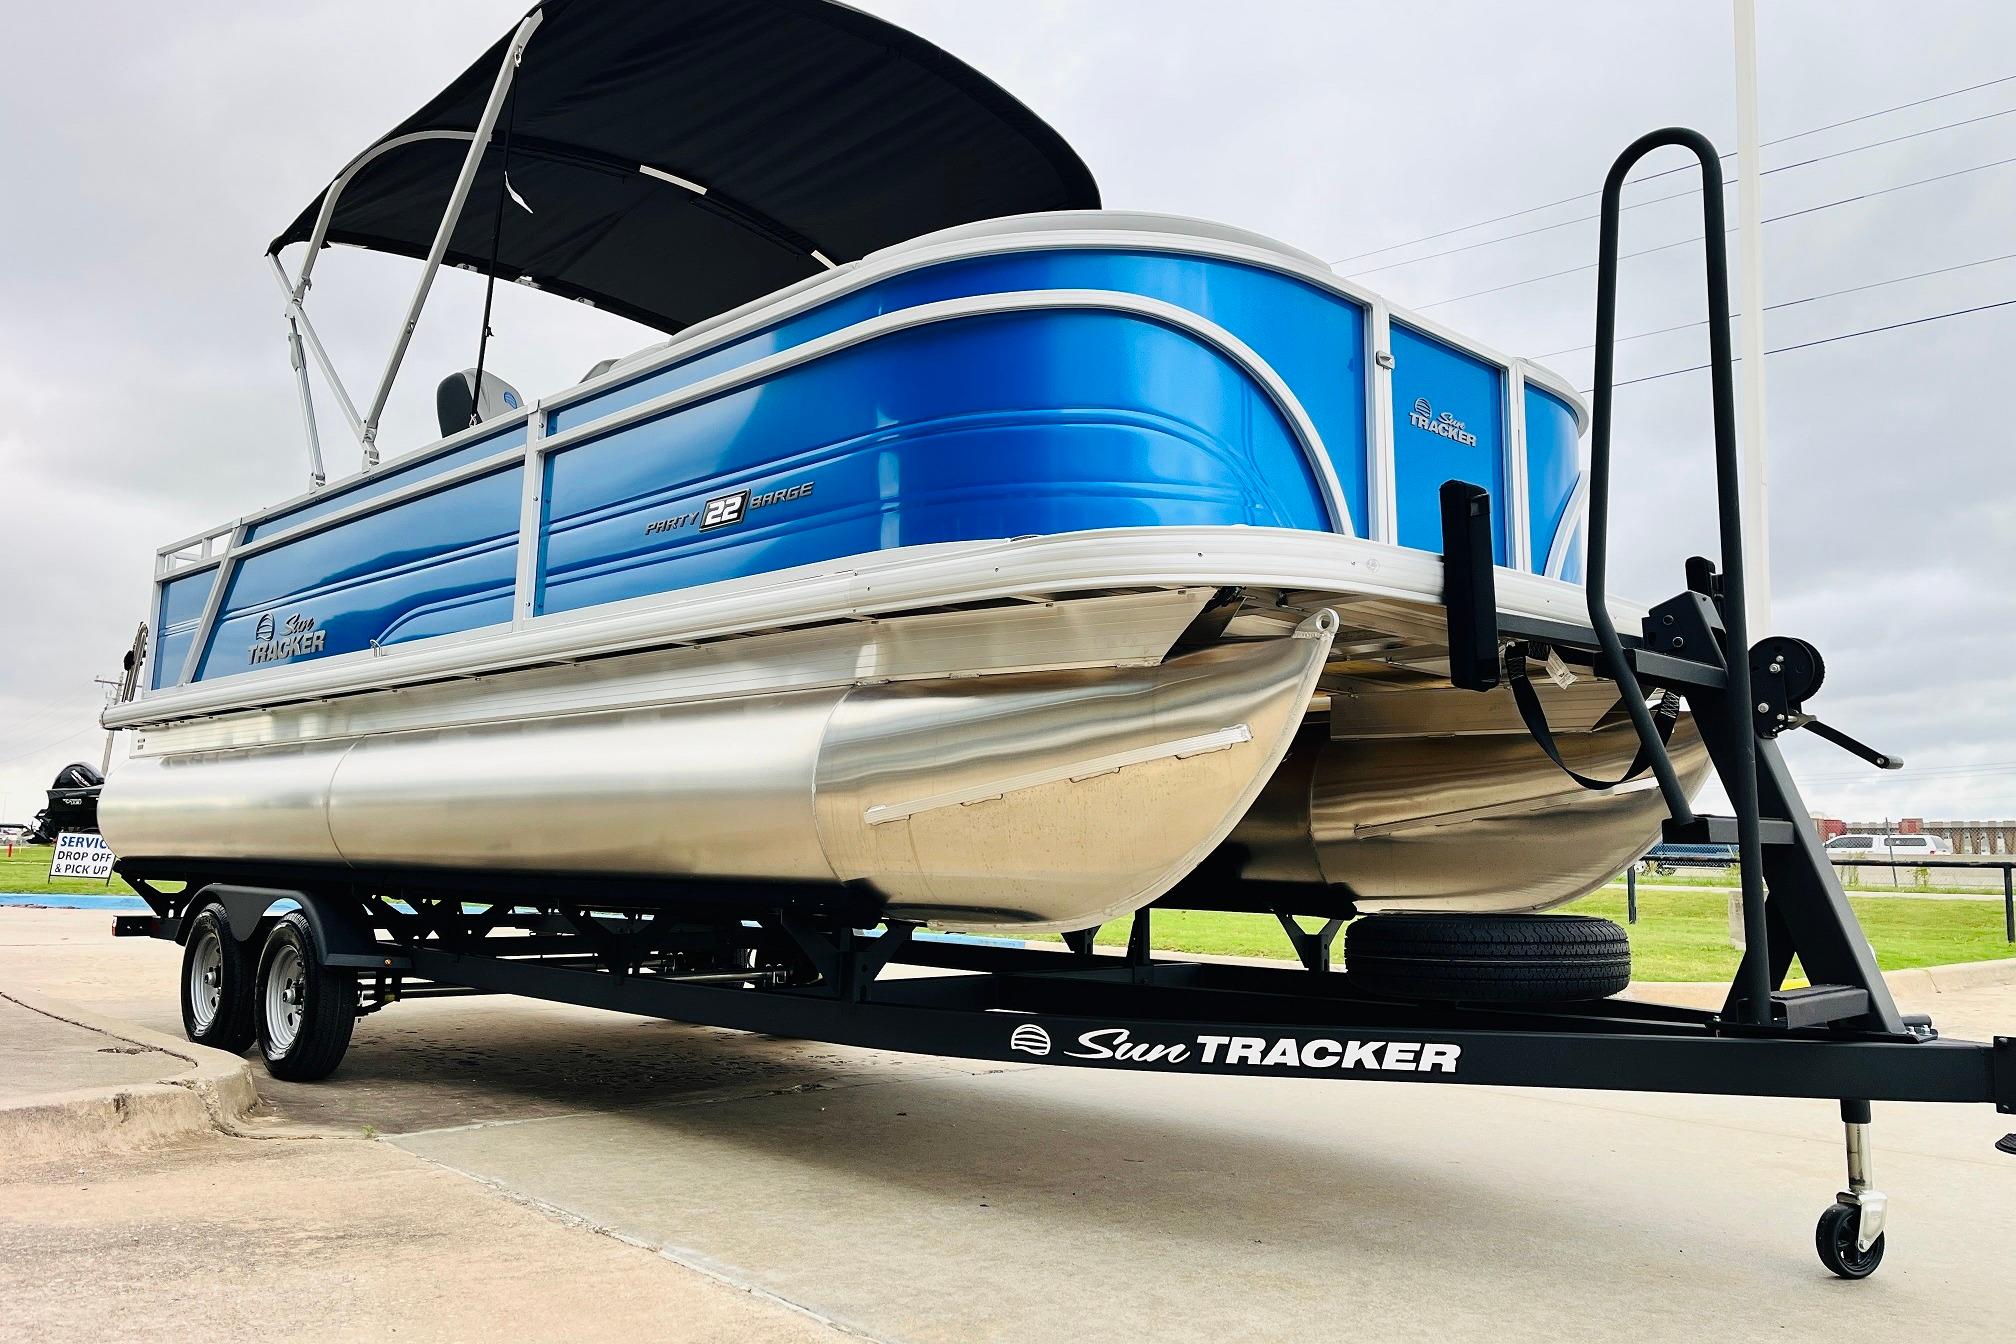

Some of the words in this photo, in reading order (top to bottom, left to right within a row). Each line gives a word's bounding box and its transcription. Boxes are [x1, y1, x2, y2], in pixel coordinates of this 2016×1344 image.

[1408, 411, 1477, 448] TRACKER
[1436, 411, 1466, 431] Sun
[645, 511, 699, 535] PARTY
[704, 496, 742, 525] 22
[750, 481, 815, 511] BARGE
[280, 612, 315, 637] Sun
[248, 630, 327, 666] TRACKER
[60, 835, 107, 849] SERVIC
[54, 863, 62, 873] &
[64, 863, 91, 875] PICK
[93, 865, 108, 875] UP
[57, 850, 89, 862] DROP
[91, 852, 112, 863] OFF
[1063, 1028, 1192, 1064] Sun
[1197, 1034, 1462, 1074] TRACKER
